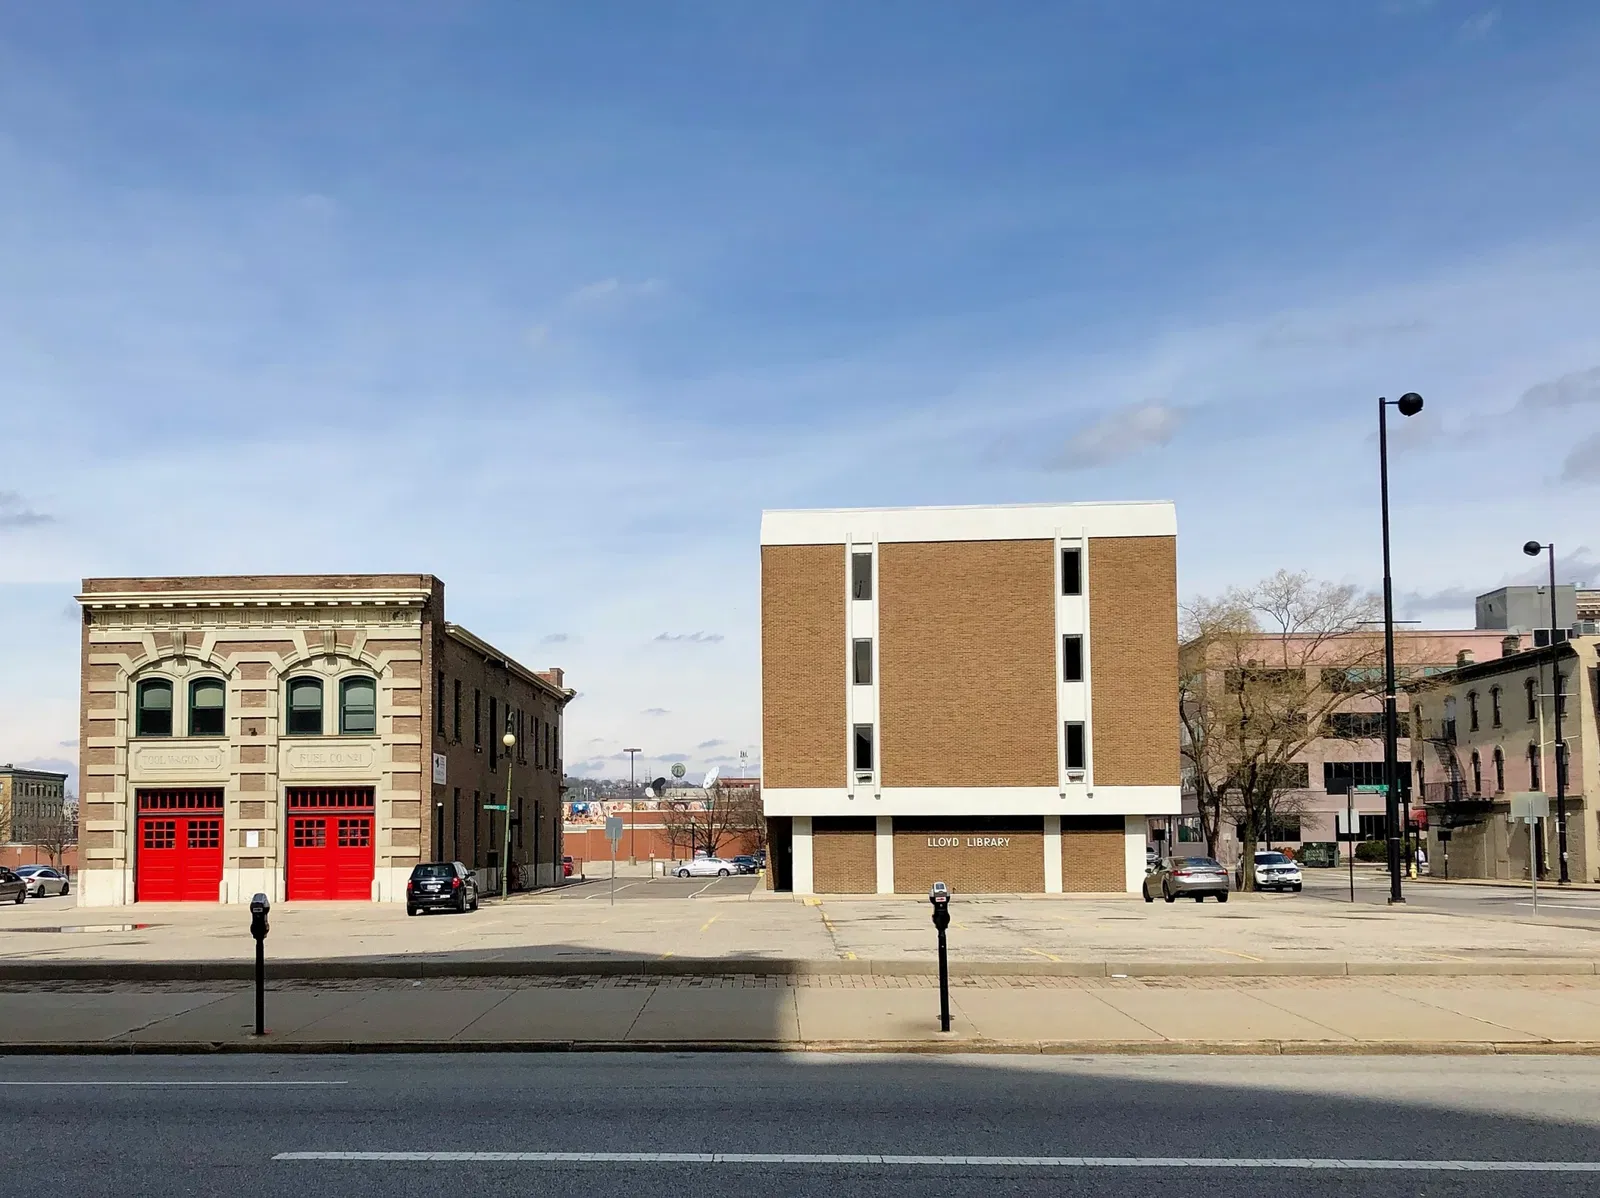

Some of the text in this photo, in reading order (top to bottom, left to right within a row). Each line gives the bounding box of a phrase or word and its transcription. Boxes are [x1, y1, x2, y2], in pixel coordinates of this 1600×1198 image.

[141, 755, 167, 764] TOOL
[168, 755, 199, 764] WAGON
[300, 753, 327, 763] FUEL
[927, 837, 1011, 847] LLOYD LIBRARY
